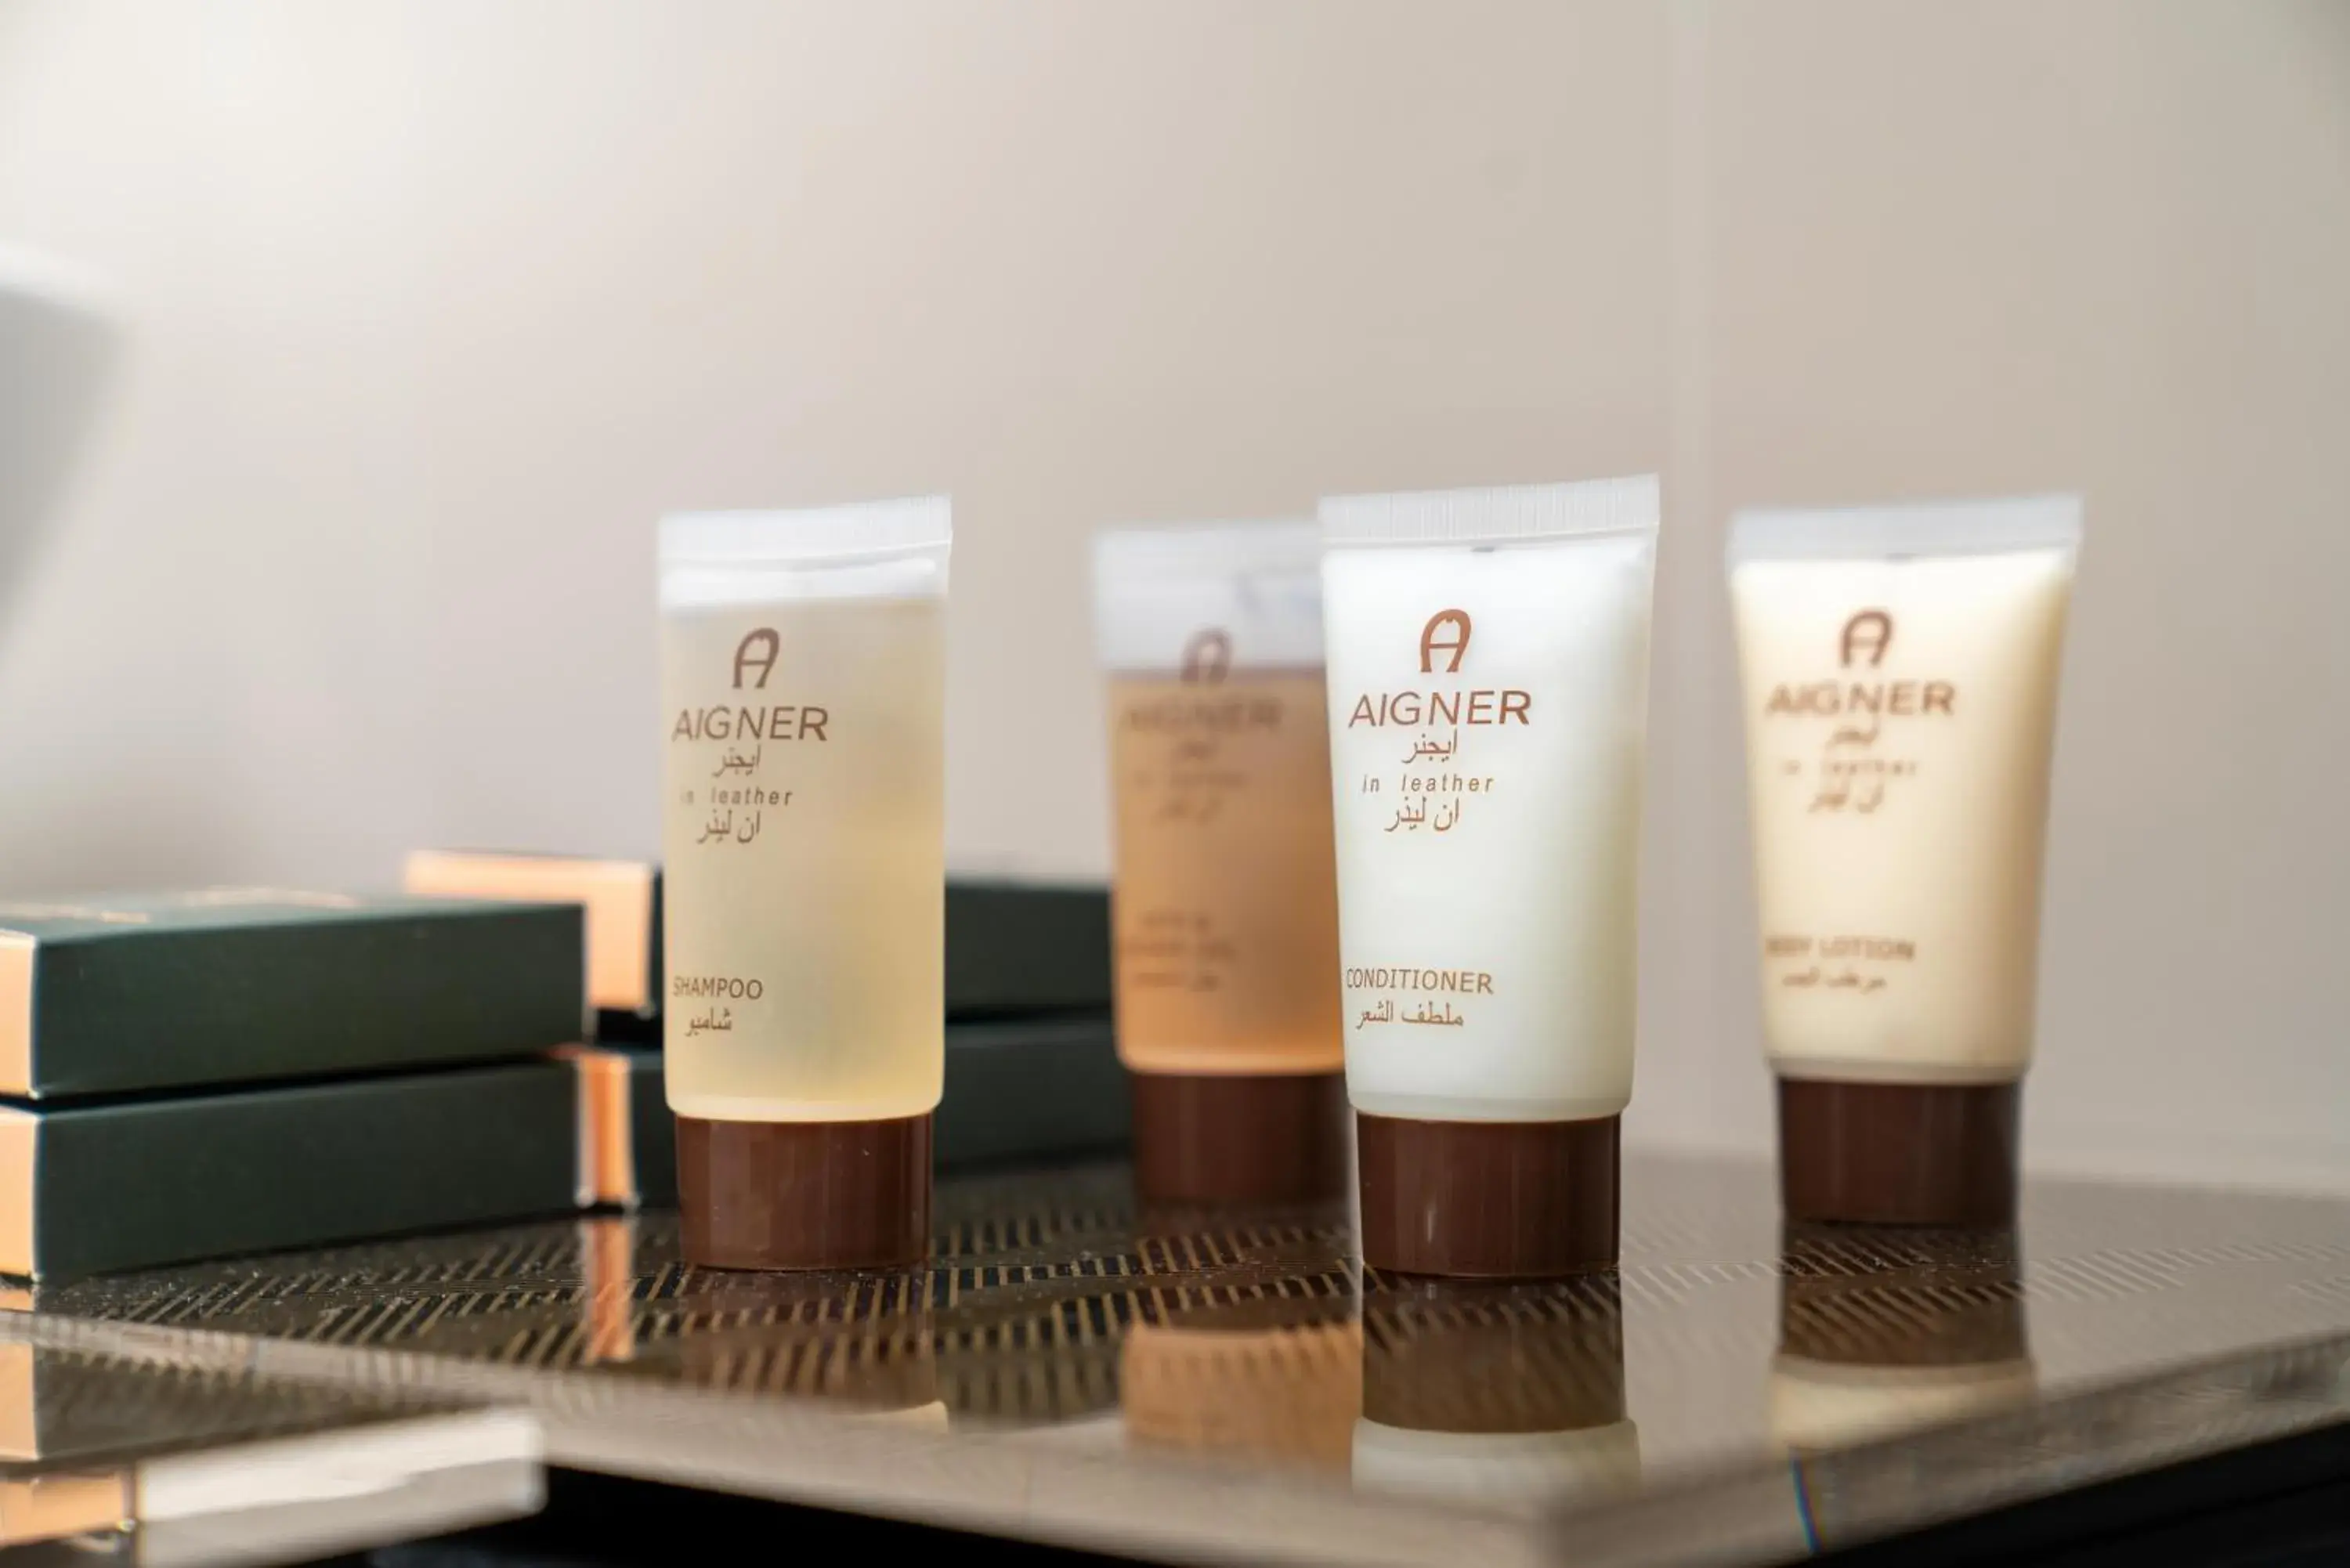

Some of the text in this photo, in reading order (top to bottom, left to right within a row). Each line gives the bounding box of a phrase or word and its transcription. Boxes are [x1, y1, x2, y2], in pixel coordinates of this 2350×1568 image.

[1420, 609, 1472, 673] A
[732, 627, 780, 689] A
[671, 706, 829, 742] AIGNER
[1348, 690, 1532, 728] AIGNER
[710, 786, 793, 807] leather
[1362, 773, 1495, 793] in leather
[1434, 797, 1460, 831] ان
[673, 976, 764, 999] SHAMPOO
[1346, 968, 1495, 995] CONDITIONER
[1401, 1000, 1464, 1027] ملطف
